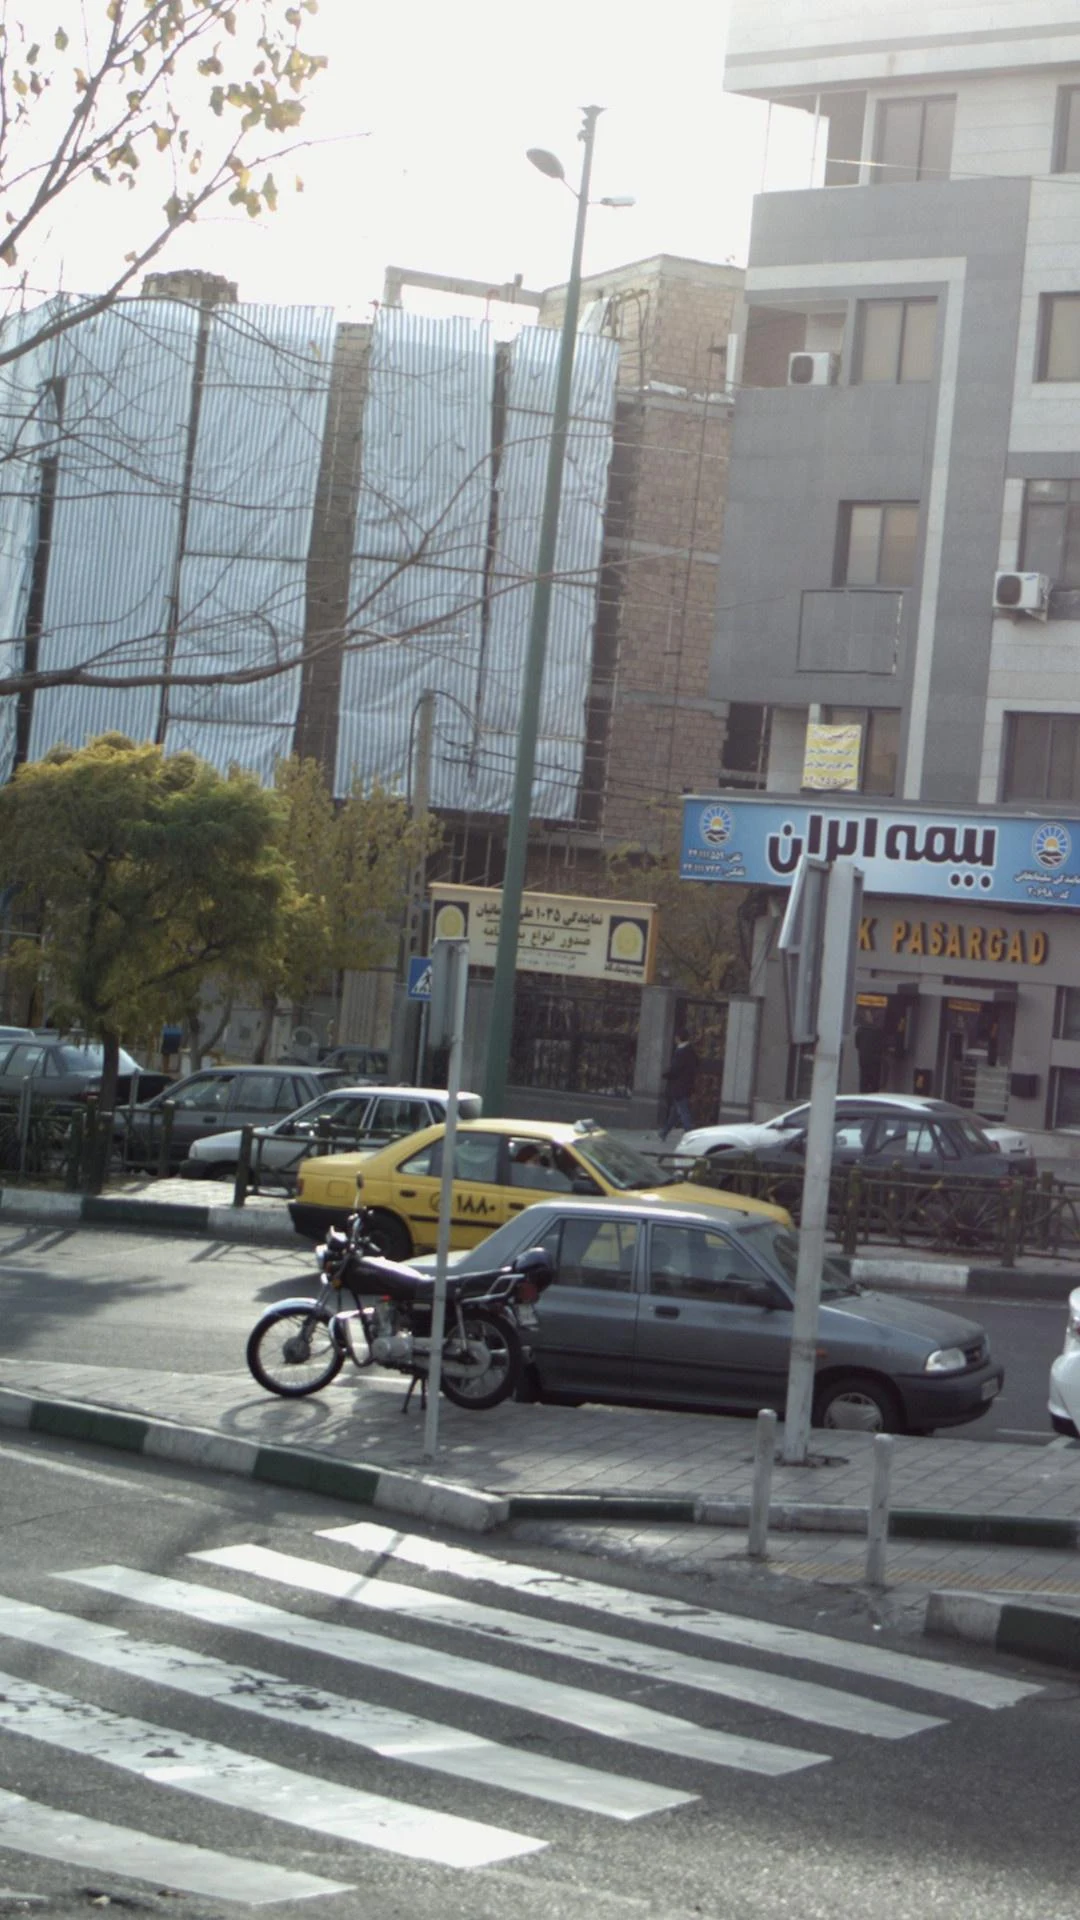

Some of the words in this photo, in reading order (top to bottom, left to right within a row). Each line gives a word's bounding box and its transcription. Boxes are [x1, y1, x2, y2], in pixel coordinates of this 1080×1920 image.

[768, 815, 878, 874] ایران
[884, 824, 996, 888] بیمه
[536, 907, 562, 922] ۱۰۳۵
[562, 911, 603, 927] نمایندگی
[530, 930, 556, 948] انواع
[560, 936, 591, 949] صدور
[893, 919, 1047, 966] PASARGAD
[456, 1193, 496, 1216] ۱۸۸۰
